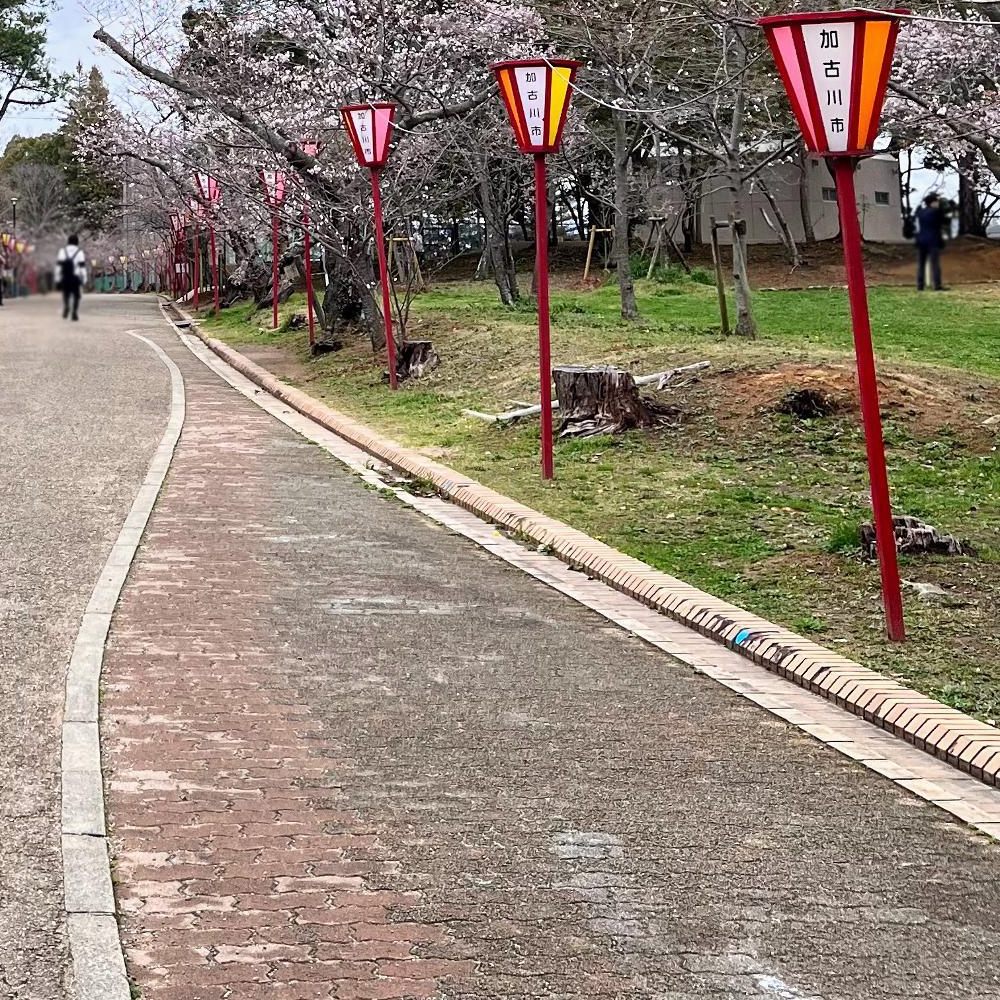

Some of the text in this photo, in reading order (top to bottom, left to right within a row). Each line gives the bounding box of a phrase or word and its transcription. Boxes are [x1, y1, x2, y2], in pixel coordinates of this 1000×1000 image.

[525, 72, 541, 136] 加古川市
[820, 29, 844, 133] 加古川市
[357, 112, 371, 155] 加古川市
